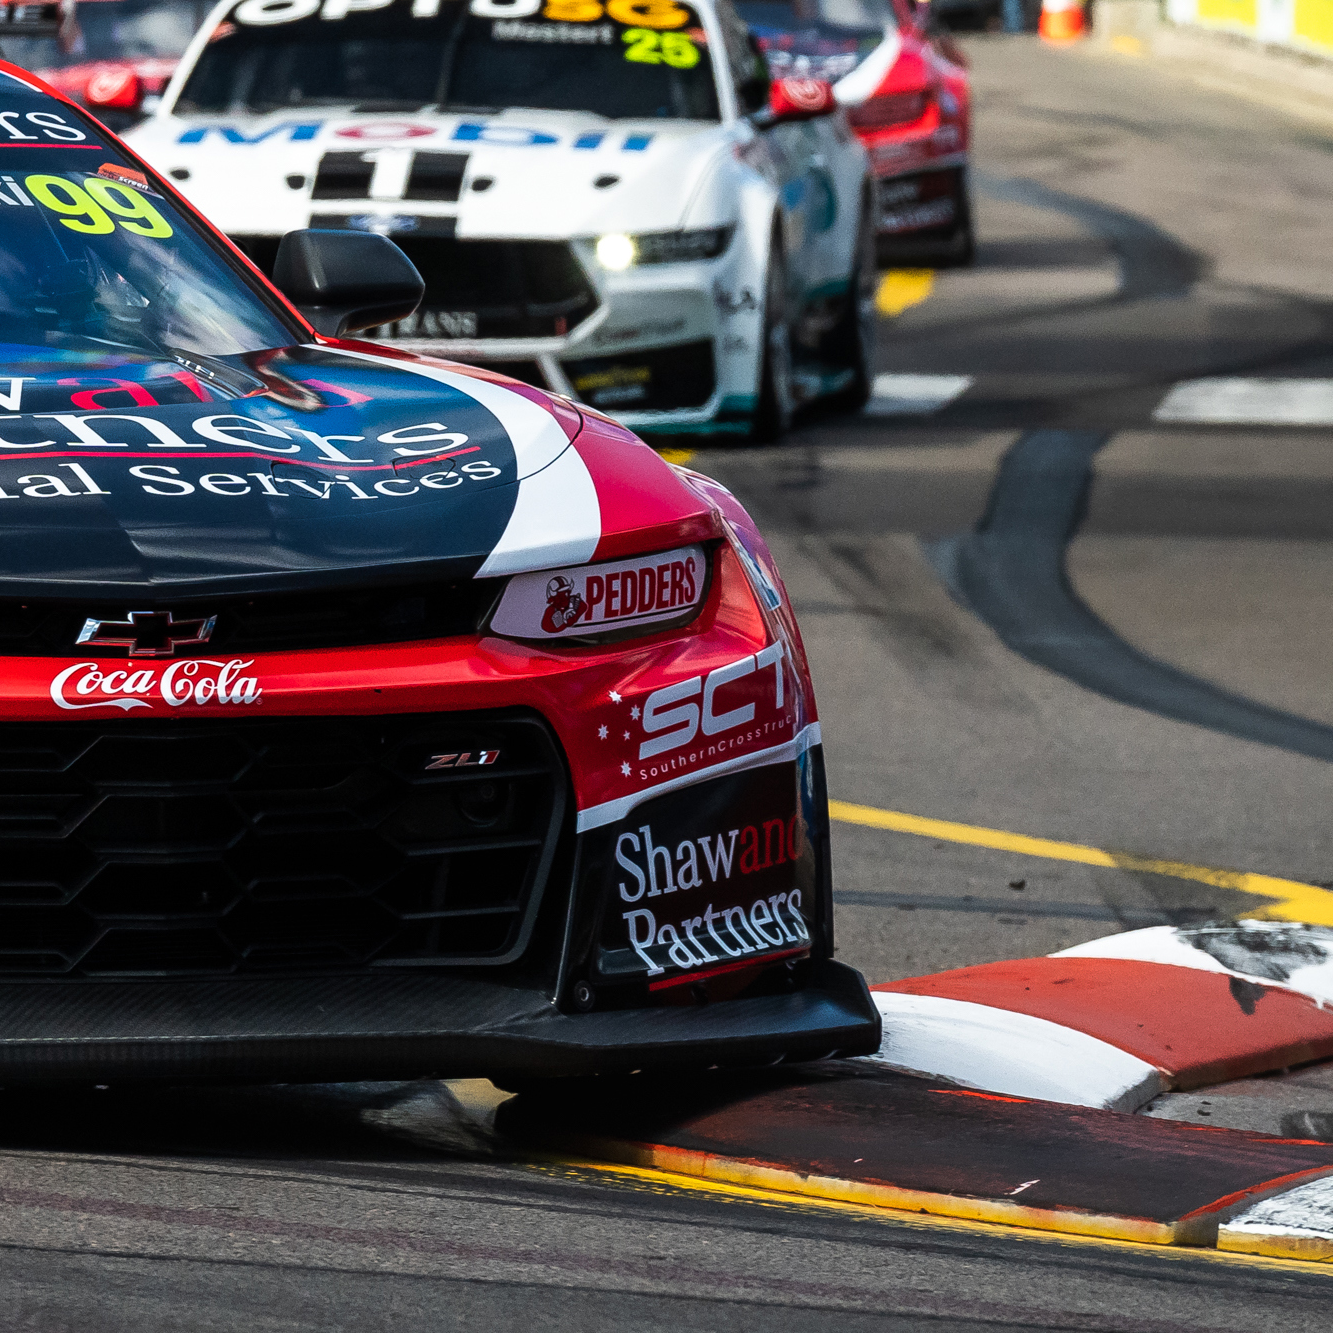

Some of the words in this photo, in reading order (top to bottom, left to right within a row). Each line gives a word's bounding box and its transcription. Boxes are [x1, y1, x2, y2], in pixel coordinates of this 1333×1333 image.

[622, 29, 699, 68] 25
[25, 173, 173, 239] 99
[128, 459, 502, 501] Services
[584, 556, 697, 624] PEDDERS
[622, 887, 810, 976] Partners
